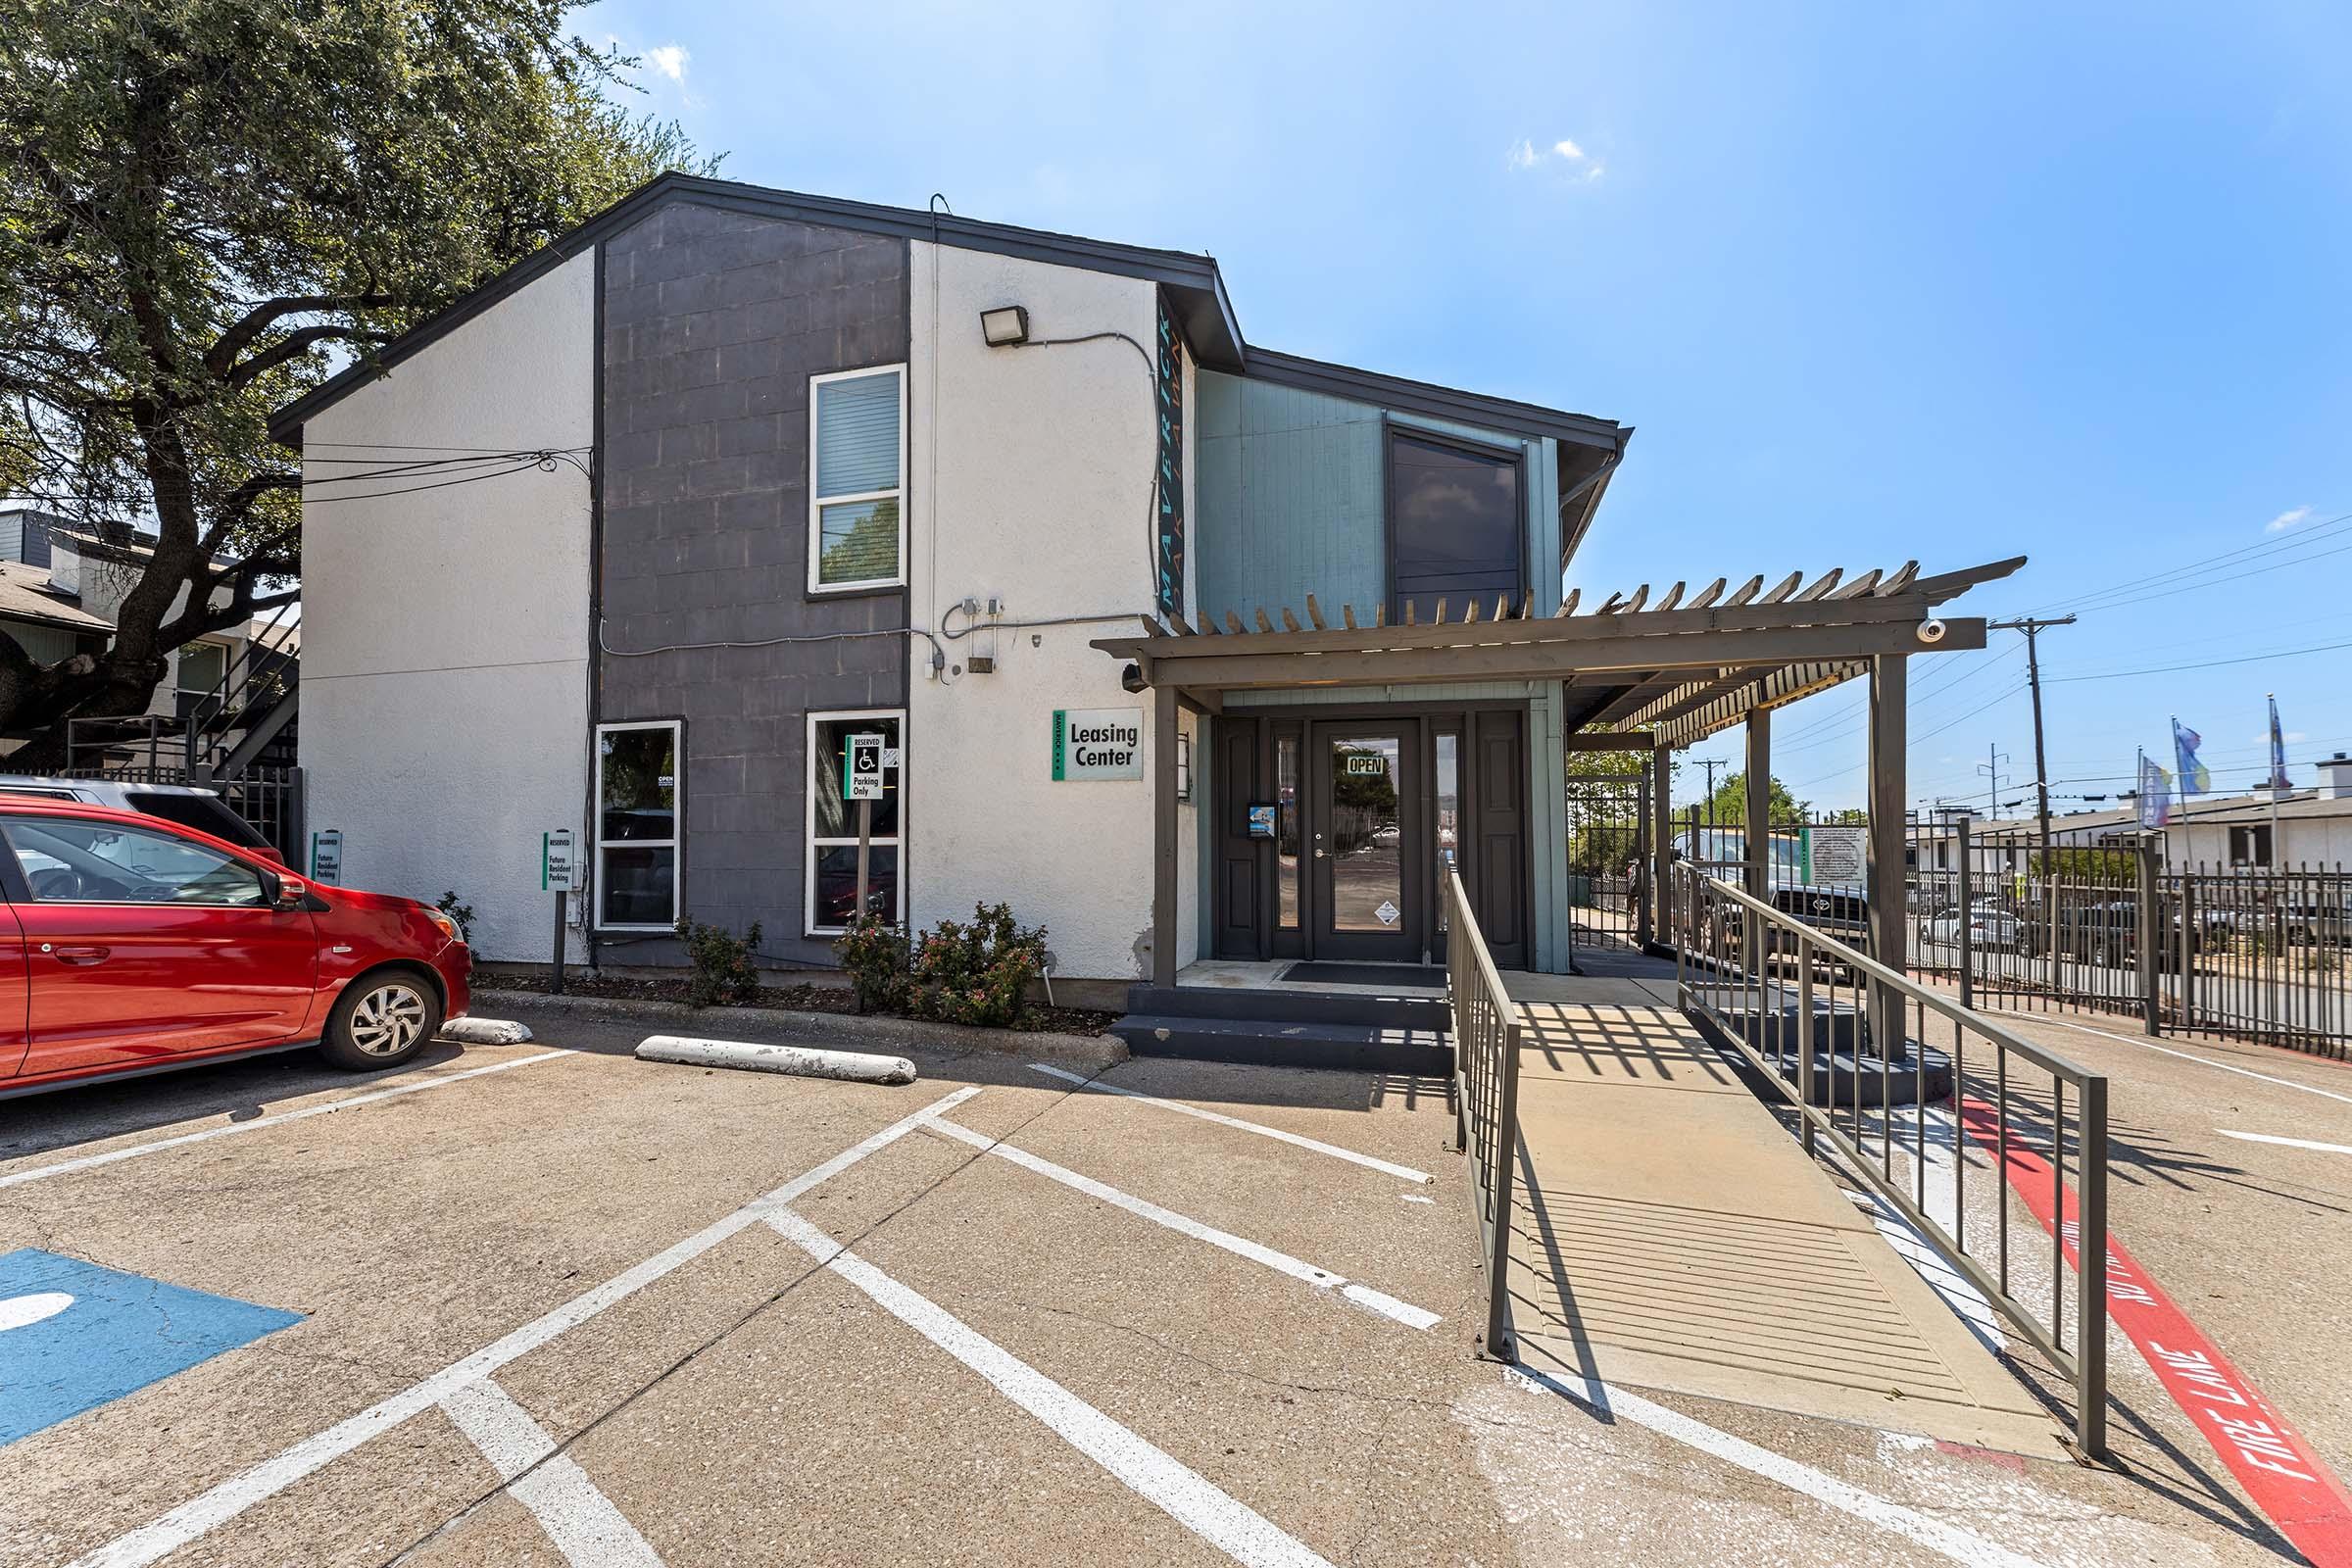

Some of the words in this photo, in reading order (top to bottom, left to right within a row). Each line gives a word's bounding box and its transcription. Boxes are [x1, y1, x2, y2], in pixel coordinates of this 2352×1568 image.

[1159, 304, 1174, 611] MAVERICK
[1071, 723, 1138, 748] Leasing
[1075, 747, 1134, 766] Center
[1349, 758, 1382, 773] OPEN
[854, 776, 879, 788] Parking
[854, 787, 869, 797] Only
[549, 864, 571, 873] Resident
[549, 873, 568, 883] Parking
[2147, 1341, 2250, 1407] LANE
[2206, 1408, 2318, 1483] FIRE
